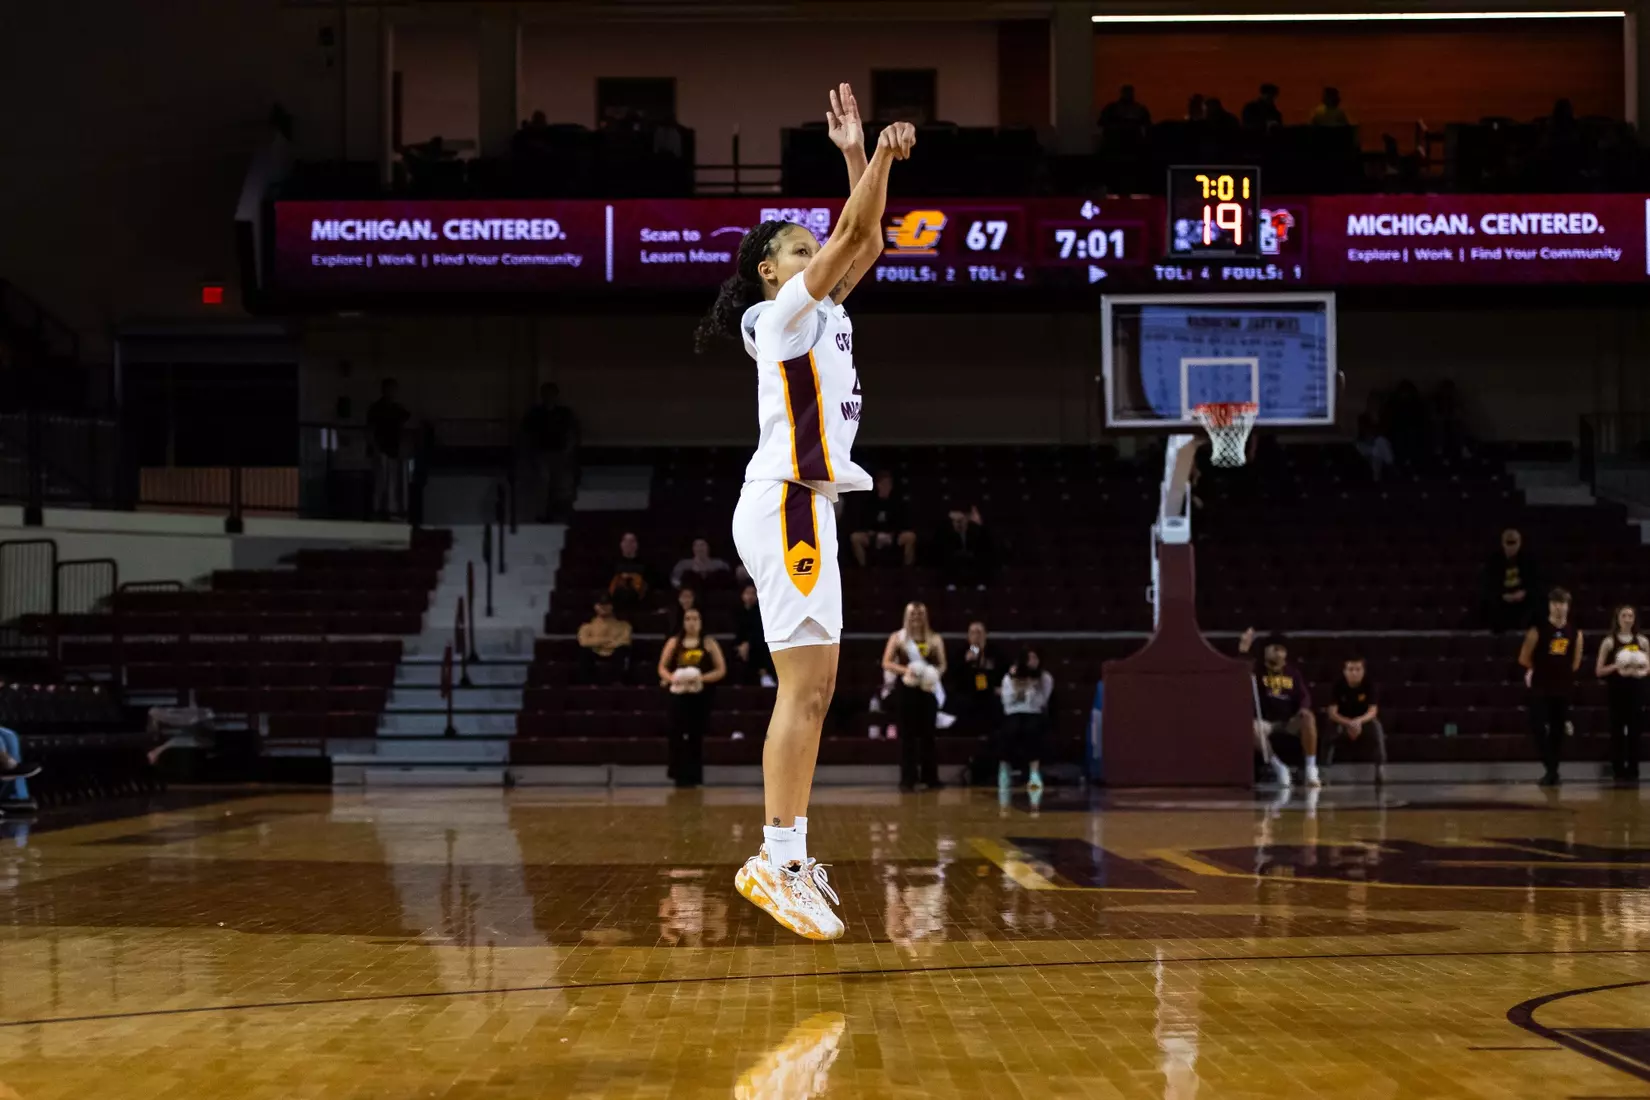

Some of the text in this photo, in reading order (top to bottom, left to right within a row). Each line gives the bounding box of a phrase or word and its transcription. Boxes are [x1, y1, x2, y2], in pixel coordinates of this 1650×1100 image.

[1195, 174, 1250, 201] 7:01
[311, 219, 566, 240] MICHIGAN. CENTERED.
[1203, 202, 1242, 246] 19
[1347, 213, 1604, 235] MICHIGAN. CENTERED.
[640, 228, 702, 243] Scan to
[966, 221, 1008, 251] 67
[1055, 229, 1124, 259] 7:01
[311, 254, 363, 267] Explore
[378, 254, 416, 266] Work
[433, 254, 464, 266] Find
[466, 253, 498, 266] Your
[501, 253, 582, 267] Community
[640, 248, 731, 263] Learn More
[1347, 248, 1401, 263] Explore
[1414, 247, 1453, 261] Work
[1471, 247, 1501, 261] Find
[1505, 247, 1537, 261] Your
[1540, 246, 1622, 262] Community
[877, 266, 956, 282] FOULS: 2
[969, 266, 1025, 281] TOL: 4
[1154, 265, 1210, 280] TOL: 4
[1222, 264, 1302, 280] FOULS: 1
